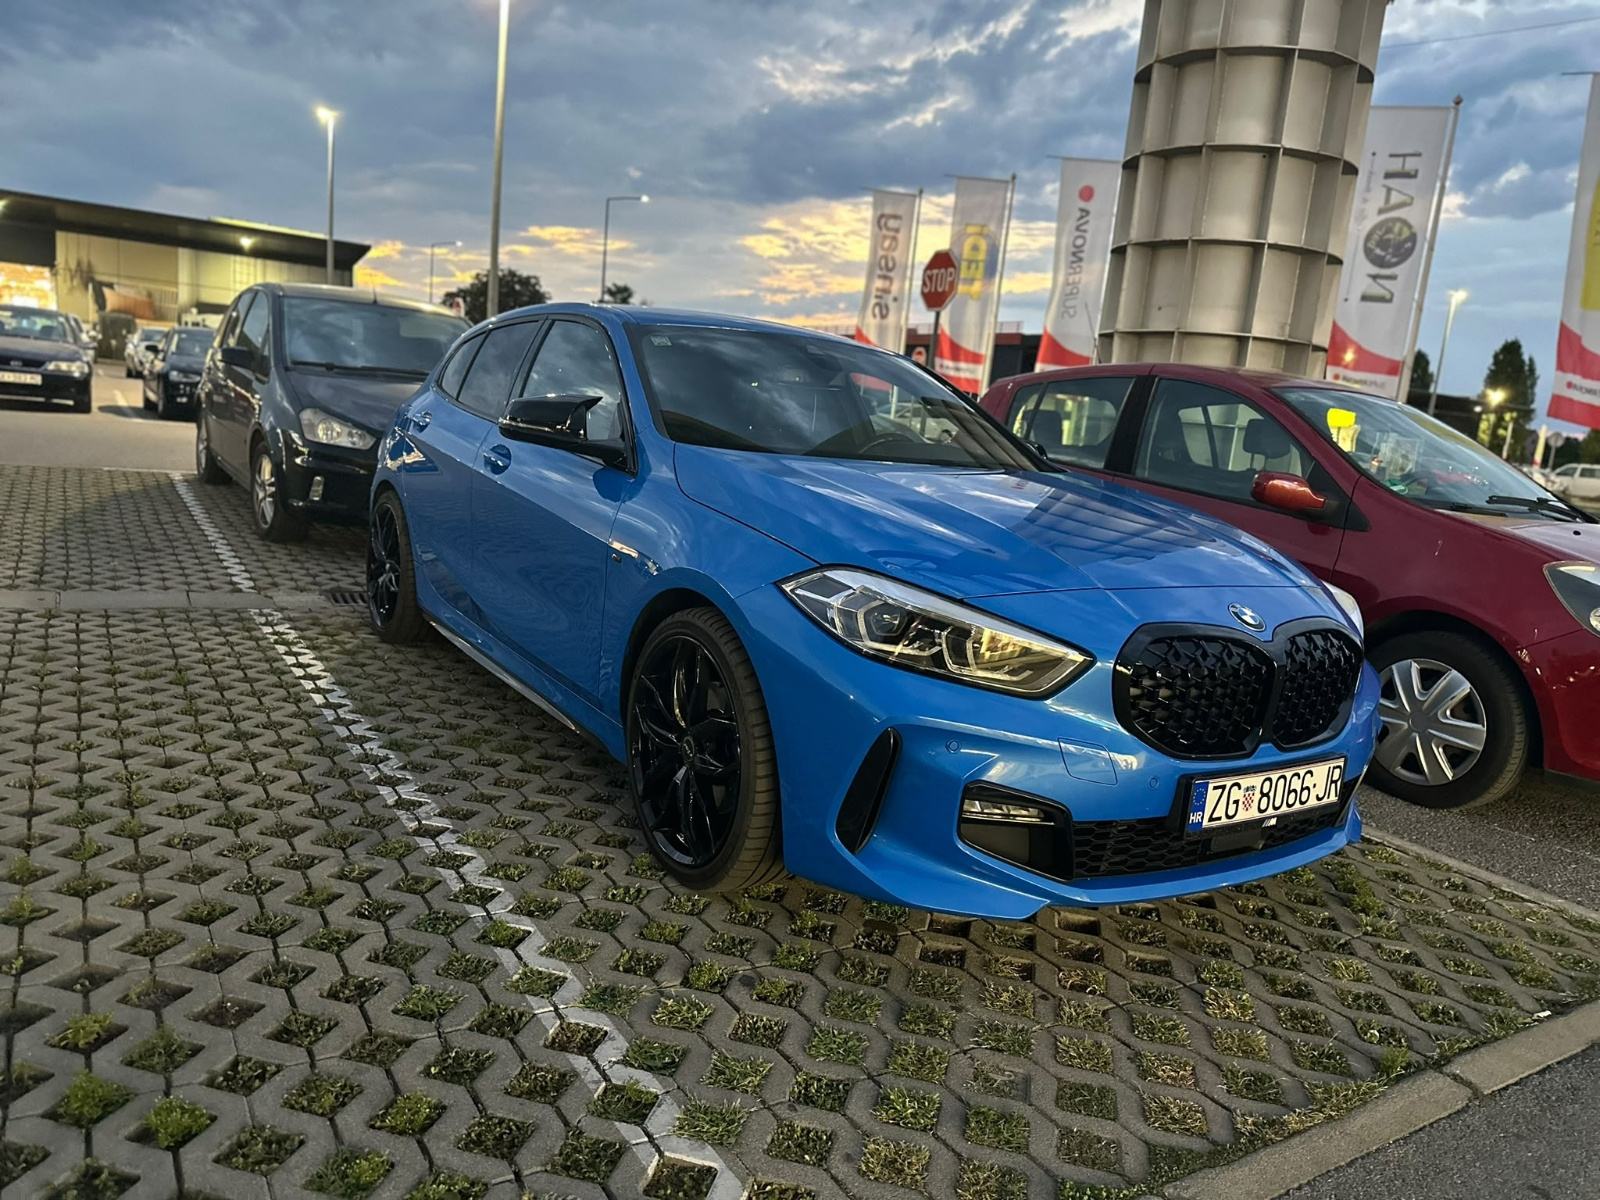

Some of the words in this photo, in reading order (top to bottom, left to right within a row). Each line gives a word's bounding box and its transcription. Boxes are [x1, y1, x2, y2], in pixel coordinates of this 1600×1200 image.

[922, 267, 955, 293] STOP
[1207, 782, 1241, 823] ZG
[1189, 812, 1203, 824] HR
